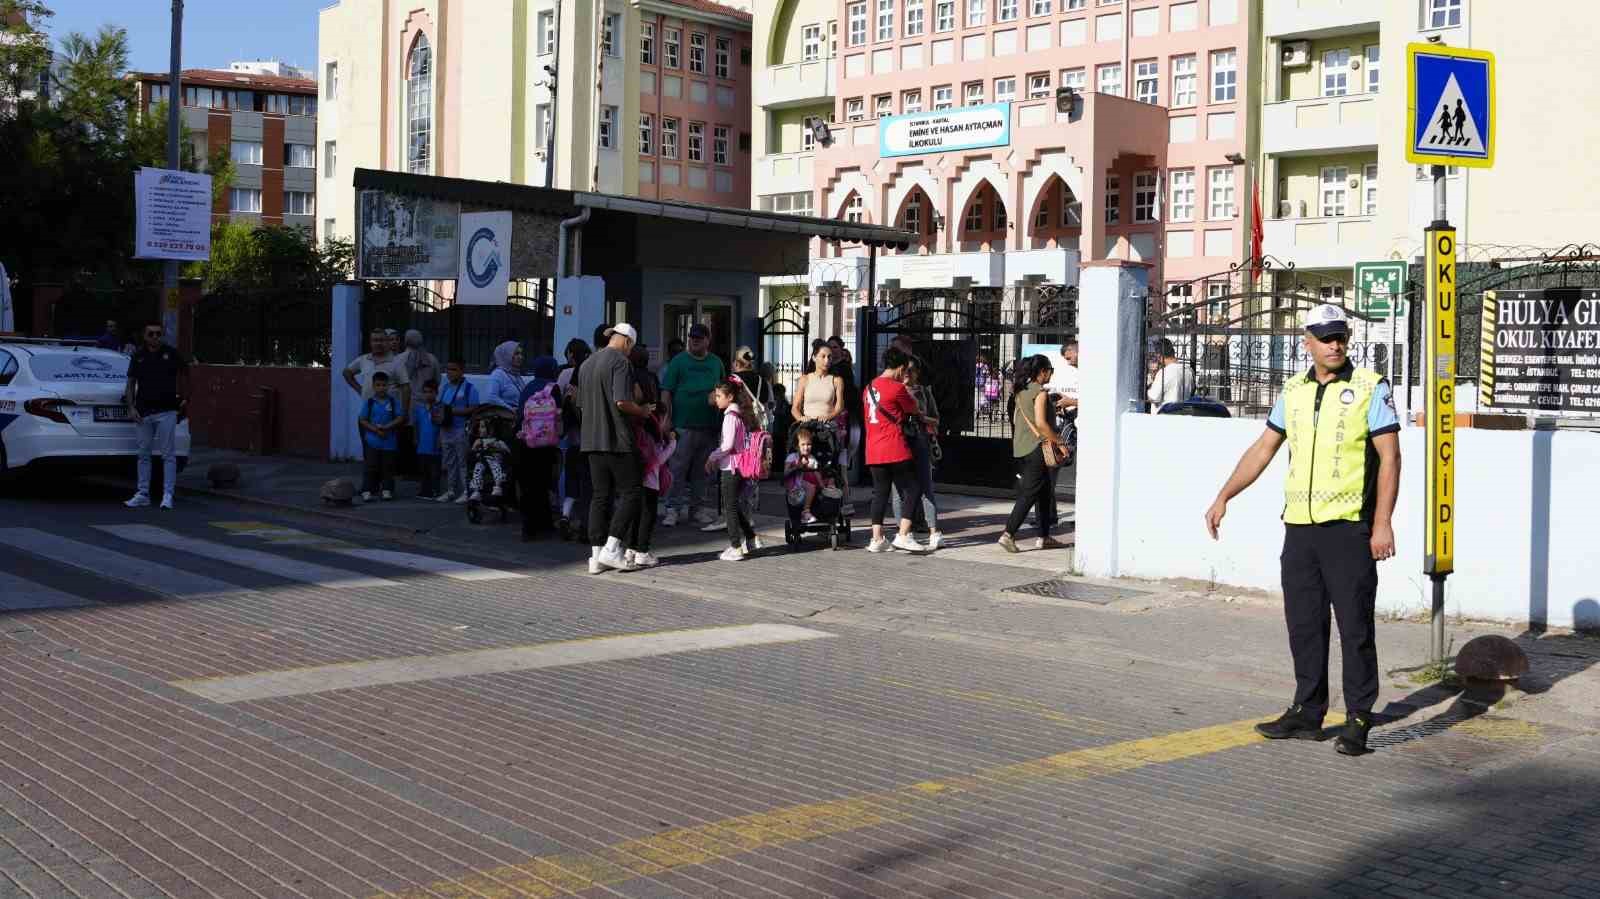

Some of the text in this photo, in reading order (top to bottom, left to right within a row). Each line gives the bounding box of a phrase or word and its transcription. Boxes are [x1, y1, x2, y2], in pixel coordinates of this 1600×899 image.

[909, 119, 1003, 137] EMİNE VE HASAN AYTAÇMAN
[909, 138, 942, 148] İLKOKULU
[1438, 236, 1452, 338] OKUL
[1497, 292, 1600, 325] HÜLYA Gİ
[1496, 329, 1538, 349] OKUL
[1495, 367, 1519, 377] KARTAL
[1570, 368, 1585, 378] TEL:
[1569, 396, 1584, 406] TEL:
[1331, 407, 1348, 479] ZABITA
[1439, 385, 1451, 555] GEÇİDİ
